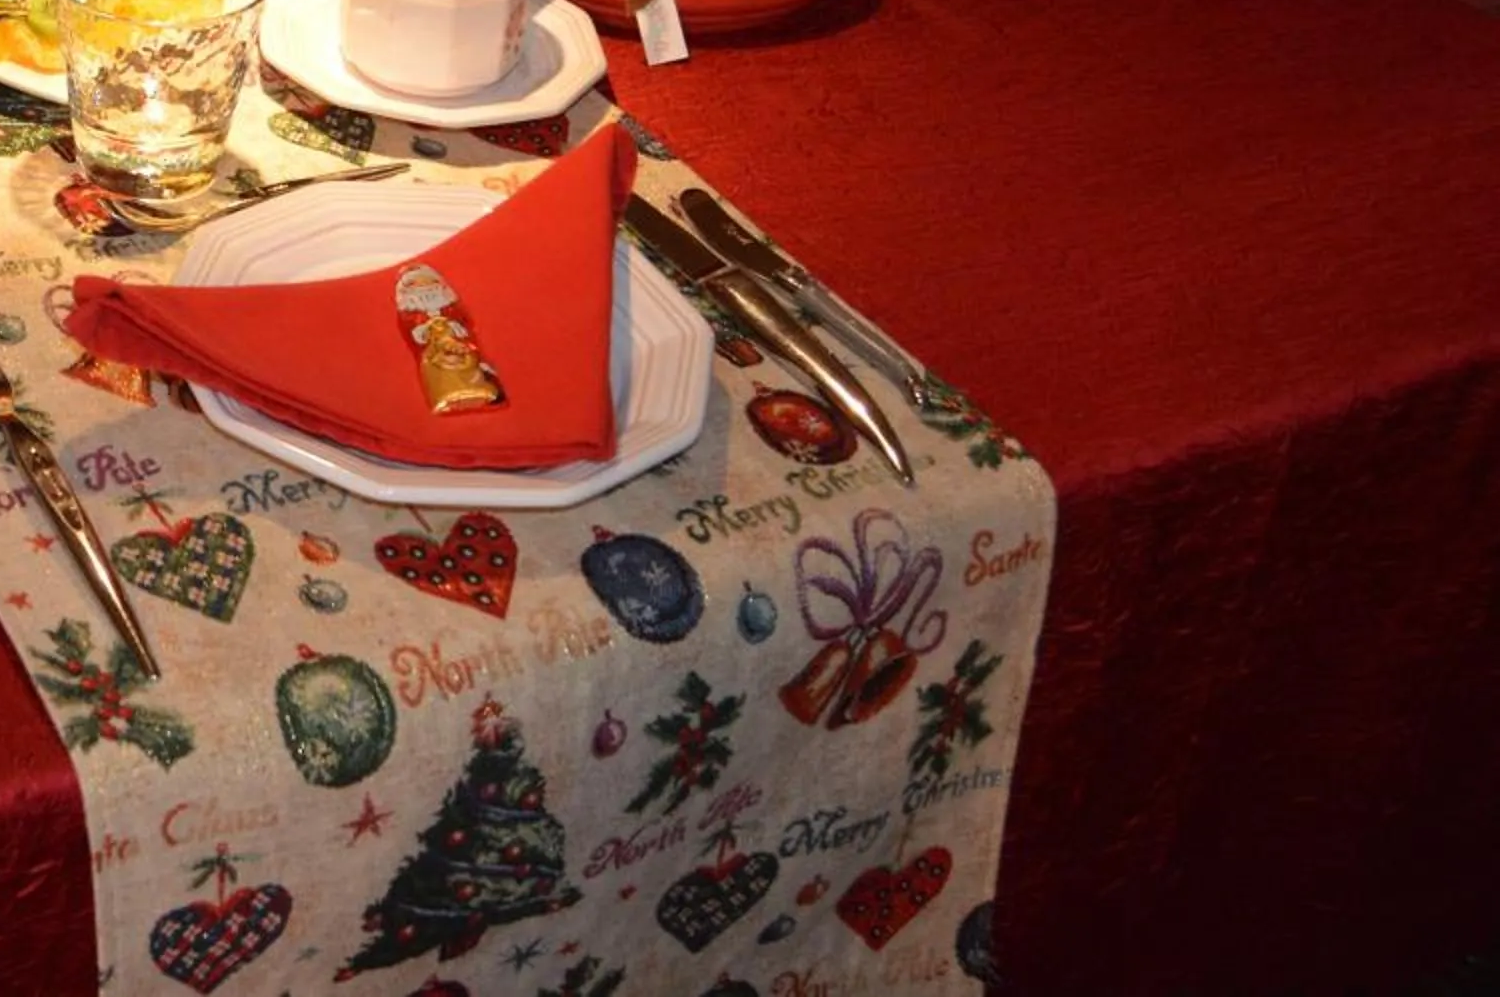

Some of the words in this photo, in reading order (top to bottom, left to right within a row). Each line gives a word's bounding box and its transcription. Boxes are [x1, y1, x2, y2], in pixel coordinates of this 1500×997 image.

[76, 445, 162, 491] Pole
[676, 494, 802, 544] Merry
[582, 819, 688, 879] North
[779, 806, 890, 858] Merry
